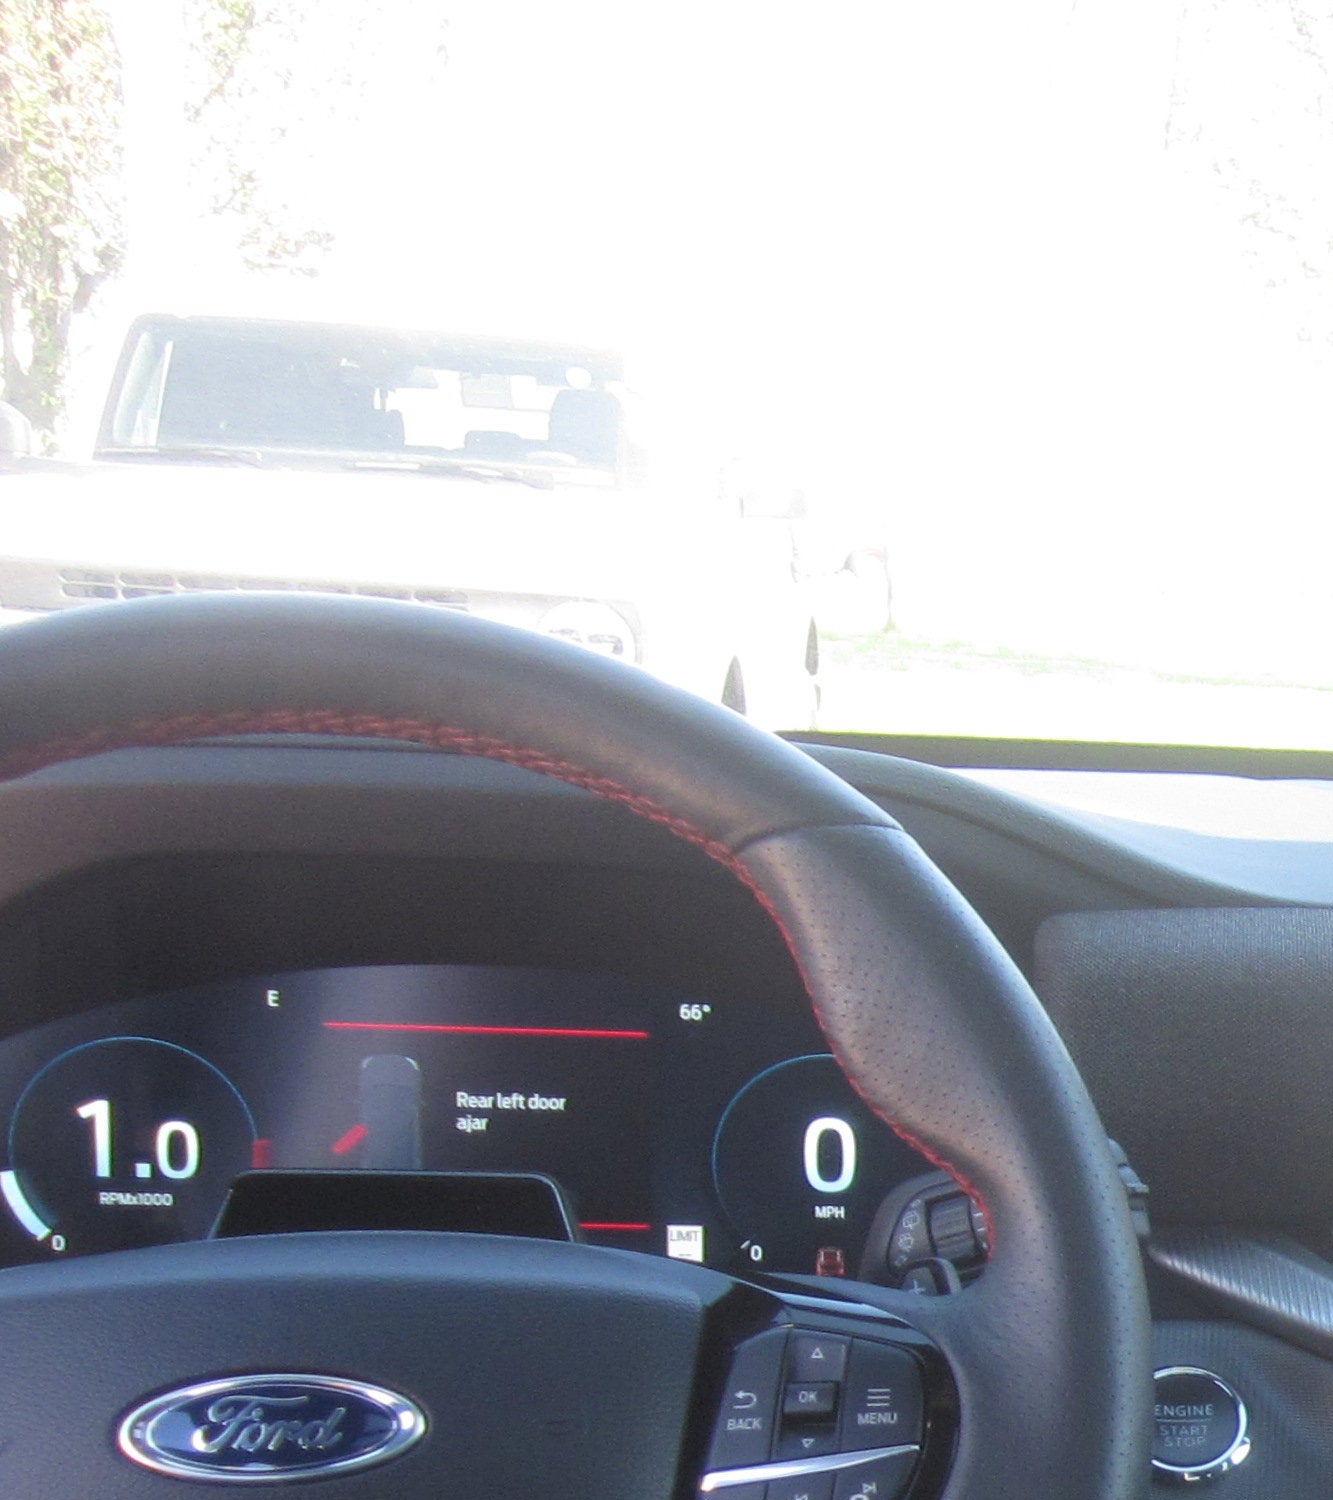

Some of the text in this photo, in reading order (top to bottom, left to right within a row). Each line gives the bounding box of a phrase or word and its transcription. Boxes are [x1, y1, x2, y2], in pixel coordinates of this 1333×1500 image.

[267, 990, 279, 1007] E
[456, 1091, 567, 1110] Rear left door
[456, 1114, 489, 1133] ajar
[76, 1099, 200, 1180] 1.0
[803, 1116, 857, 1194] 0
[815, 1205, 846, 1219] MPH
[52, 1234, 67, 1251] 0
[669, 1230, 699, 1242] LIMIT
[750, 1244, 763, 1261] 0
[798, 1390, 818, 1403] OK
[1154, 1404, 1214, 1416] ENGINE
[191, 1396, 346, 1453] Ford
[727, 1418, 762, 1431] BACK
[857, 1412, 898, 1425] MENU
[1160, 1425, 1208, 1436] START
[1164, 1436, 1207, 1447] STOP
